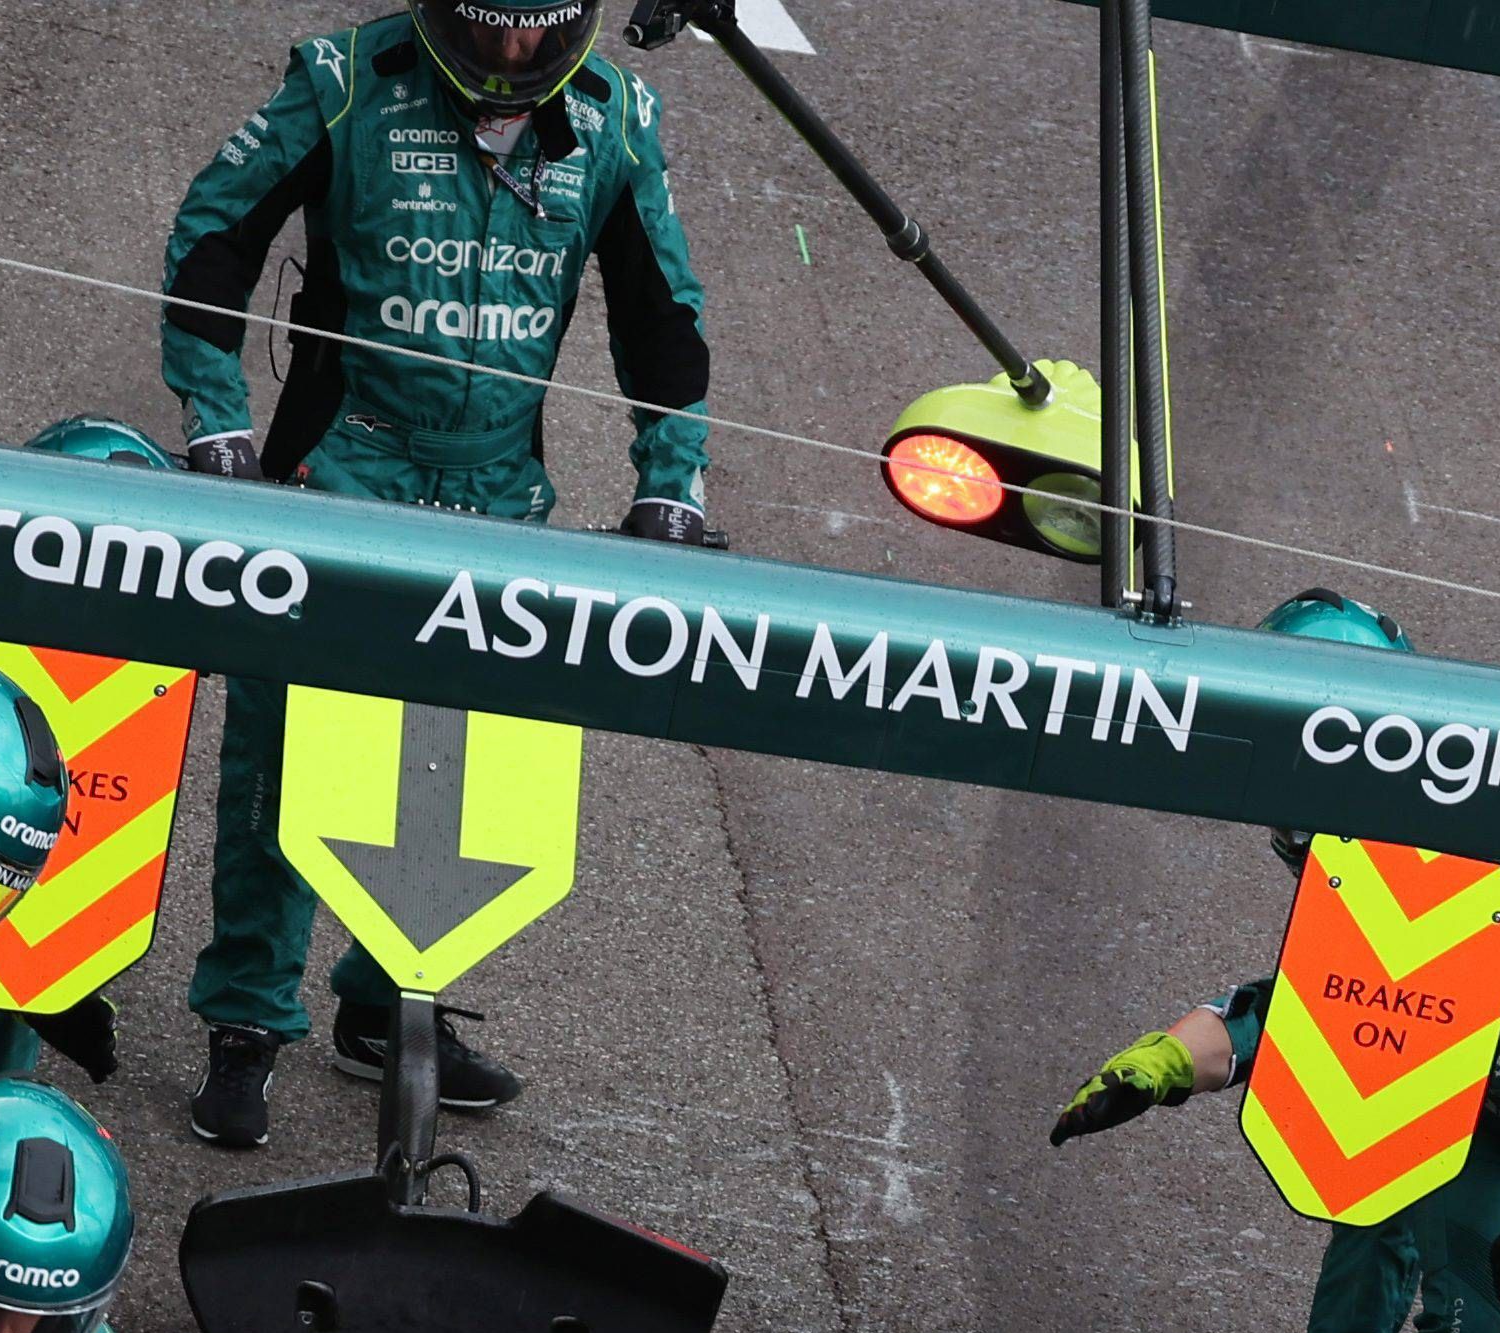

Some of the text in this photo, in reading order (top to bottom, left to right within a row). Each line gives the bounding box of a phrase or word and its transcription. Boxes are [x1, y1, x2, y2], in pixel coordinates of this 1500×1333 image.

[455, 3, 582, 28] ASTON MARTIN
[389, 129, 459, 144] aramco
[392, 152, 457, 174] JCB
[392, 199, 456, 212] SentinelOne
[386, 235, 567, 278] cognizant
[380, 295, 555, 340] aramco
[669, 505, 684, 541] HyFle
[414, 570, 1200, 754] ASTON MARTIN
[65, 769, 129, 802] KES
[1322, 973, 1456, 1025] BRAKES
[1352, 1021, 1407, 1055] ON
